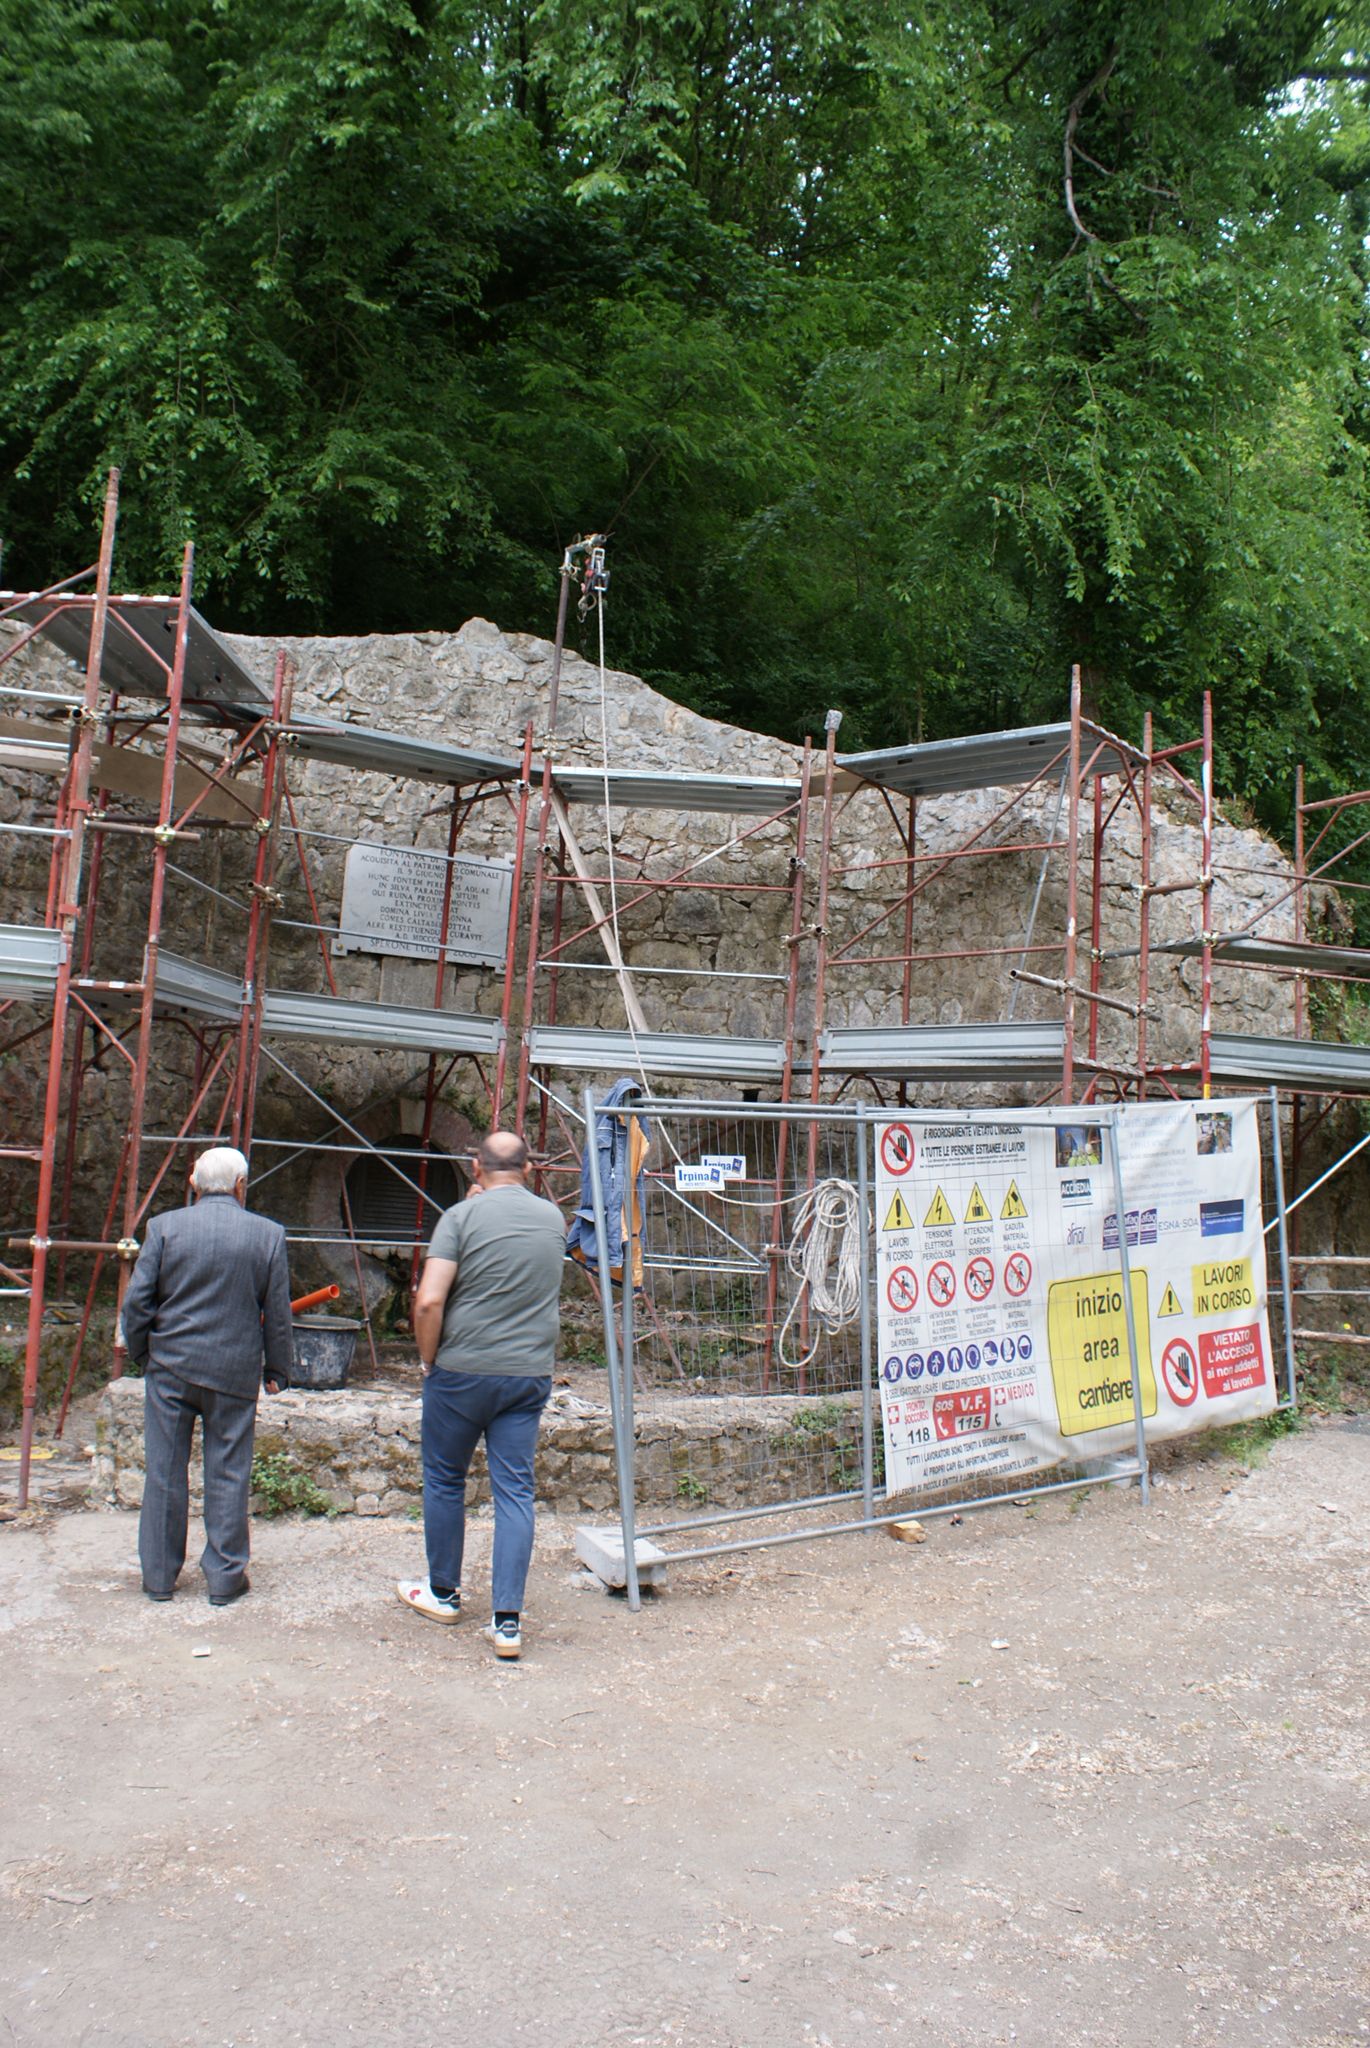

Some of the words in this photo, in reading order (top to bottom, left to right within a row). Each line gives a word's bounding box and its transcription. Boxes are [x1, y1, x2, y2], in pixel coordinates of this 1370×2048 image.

[414, 862, 458, 874] PATRIMOO
[461, 868, 499, 880] COMUNALE
[416, 870, 444, 880] GIUGNO
[368, 872, 390, 882] HUNC
[393, 876, 424, 886] FONTEM
[426, 880, 461, 891] PERENIS
[390, 884, 410, 892] SILVA
[389, 892, 413, 900] RUINA
[417, 895, 446, 904] PROXIM
[451, 900, 481, 910] MONTIS
[394, 900, 438, 911] EXTINCTUS
[440, 906, 458, 914] EAT
[380, 906, 410, 916] DOMINA
[436, 912, 472, 923] CONNA
[380, 914, 404, 924] COMES
[407, 918, 471, 932] CALTABELOTTAE
[389, 922, 446, 936] RESTITUENDU
[450, 930, 482, 941] CURAVIT
[928, 1126, 972, 1138] RIGOROSAMENTE
[974, 1125, 994, 1137] VIETATO
[920, 1147, 925, 1158] A
[926, 1146, 942, 1158] TUTTE
[943, 1146, 950, 1157] LE
[951, 1144, 974, 1156] PERSONE
[976, 1142, 1002, 1154] ESTRANEE
[1002, 1142, 1008, 1153] AI
[1008, 1141, 1026, 1153] LAVORI
[678, 1170, 710, 1182] Irpina
[926, 1230, 953, 1239] TENSIONE
[1004, 1222, 1024, 1232] CADUTA
[888, 1236, 910, 1248] LAVORI
[969, 1236, 991, 1246] CARICHI
[1003, 1231, 1029, 1242] MATERIALI
[924, 1240, 954, 1250] ELETTRICA
[886, 1252, 892, 1262] IN
[892, 1250, 914, 1261] CORSO
[922, 1250, 956, 1261] PERICOLOSA
[1204, 1264, 1244, 1286] LAVORI
[1076, 1287, 1122, 1318] inizio
[1198, 1295, 1209, 1313] IN
[1212, 1288, 1252, 1310] CORSO
[1213, 1330, 1250, 1346] VIETATO
[1083, 1336, 1120, 1362] area
[1208, 1342, 1255, 1364] L'ACCESSO
[1206, 1368, 1215, 1380] ai
[1216, 1366, 1234, 1378] non
[1234, 1356, 1260, 1374] addetti
[922, 1382, 938, 1394] USARE
[1008, 1382, 1035, 1400] MEDICO
[1222, 1380, 1230, 1392] ai
[1232, 1374, 1254, 1390] lavori
[1078, 1377, 1134, 1410] cantiere
[906, 1400, 926, 1411] PRONTO
[934, 1400, 954, 1412] SOS
[960, 1394, 986, 1412] V.F.
[904, 1410, 929, 1424] SOCCORSO
[958, 1416, 982, 1431] 115
[908, 1426, 930, 1444] 118
[906, 1454, 921, 1466] TUTTI
[924, 1448, 950, 1462] LAVORATORI
[951, 1446, 962, 1456] SONO
[929, 1464, 946, 1475] PROPRI
[946, 1462, 956, 1472] CAPI
